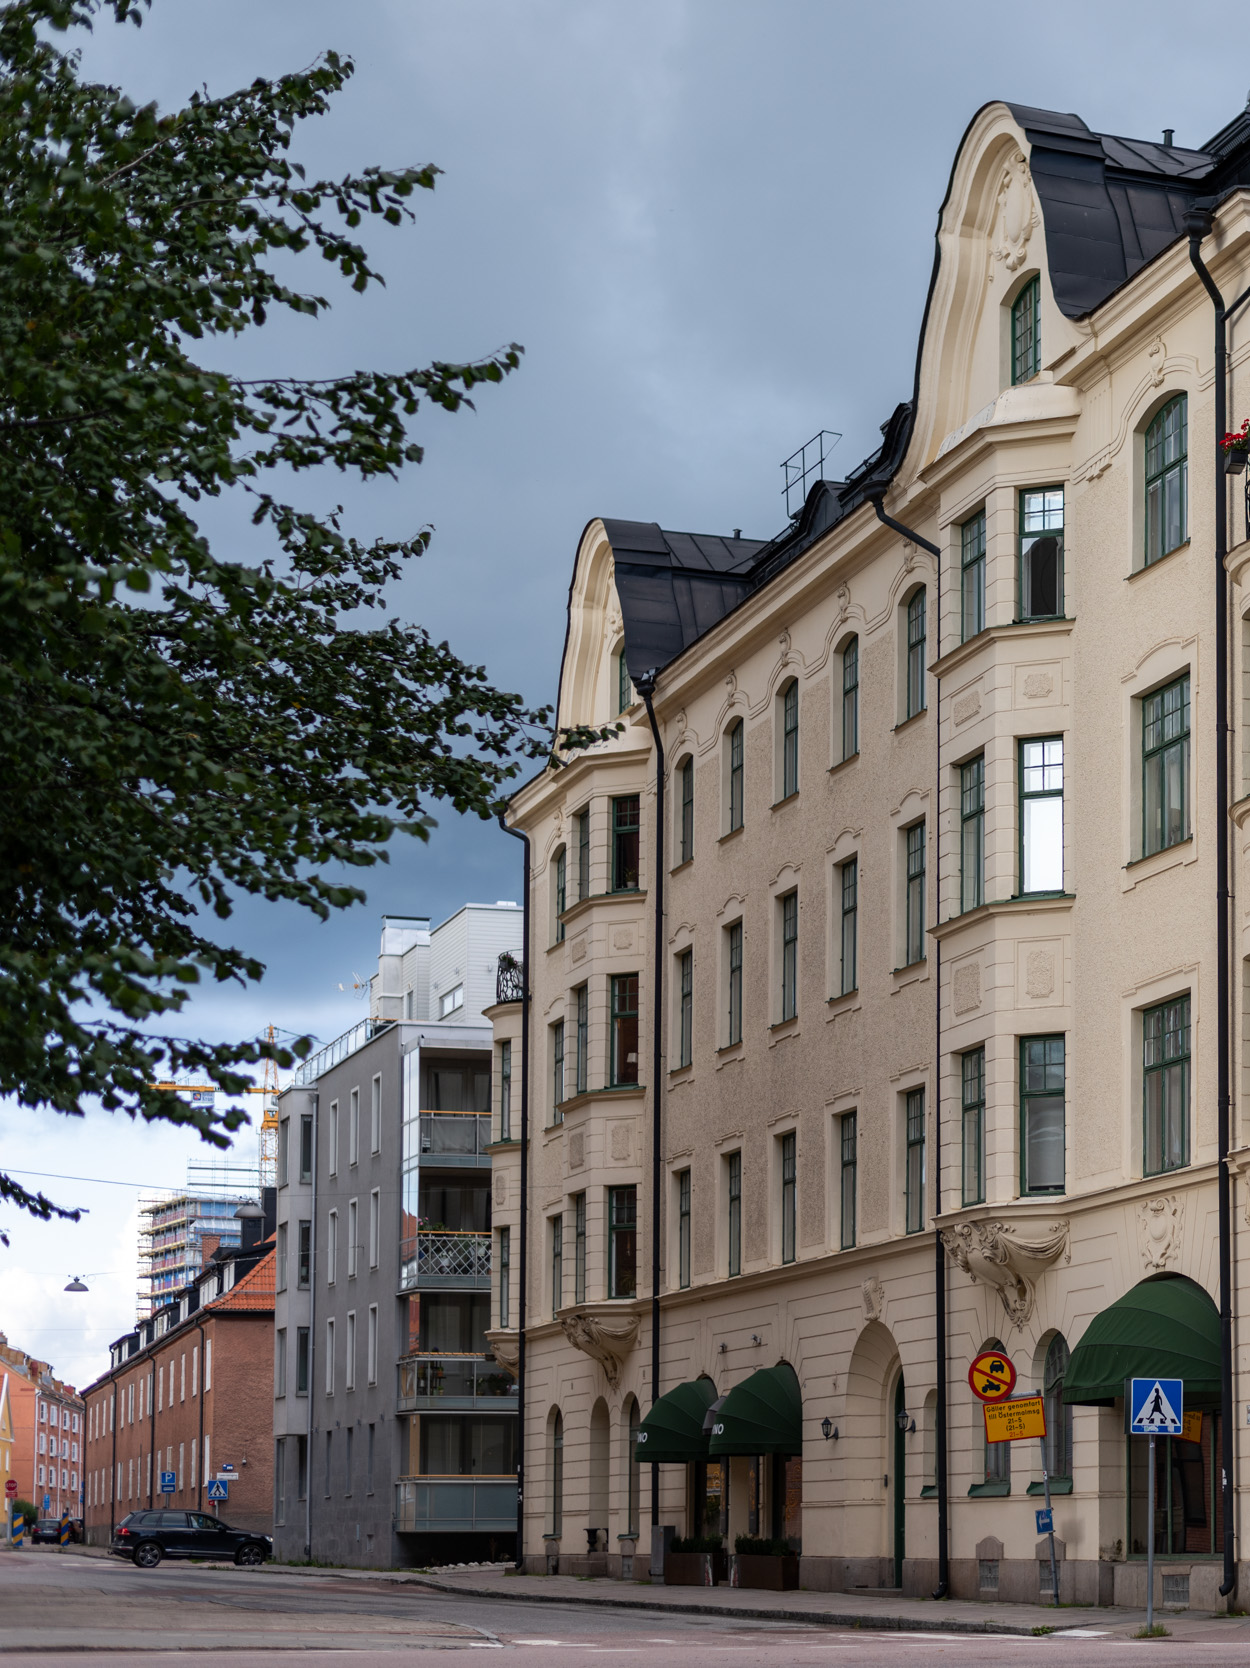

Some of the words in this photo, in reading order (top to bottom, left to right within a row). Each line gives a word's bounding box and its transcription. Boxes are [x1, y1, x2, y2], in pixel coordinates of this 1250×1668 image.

[986, 1405, 1006, 1413] Gäller
[1007, 1400, 1041, 1411] genomfart
[998, 1407, 1040, 1419] Östermalmsg
[1005, 1423, 1026, 1432] (21-5)
[1008, 1430, 1024, 1438] 21-5
[165, 1473, 173, 1483] P
